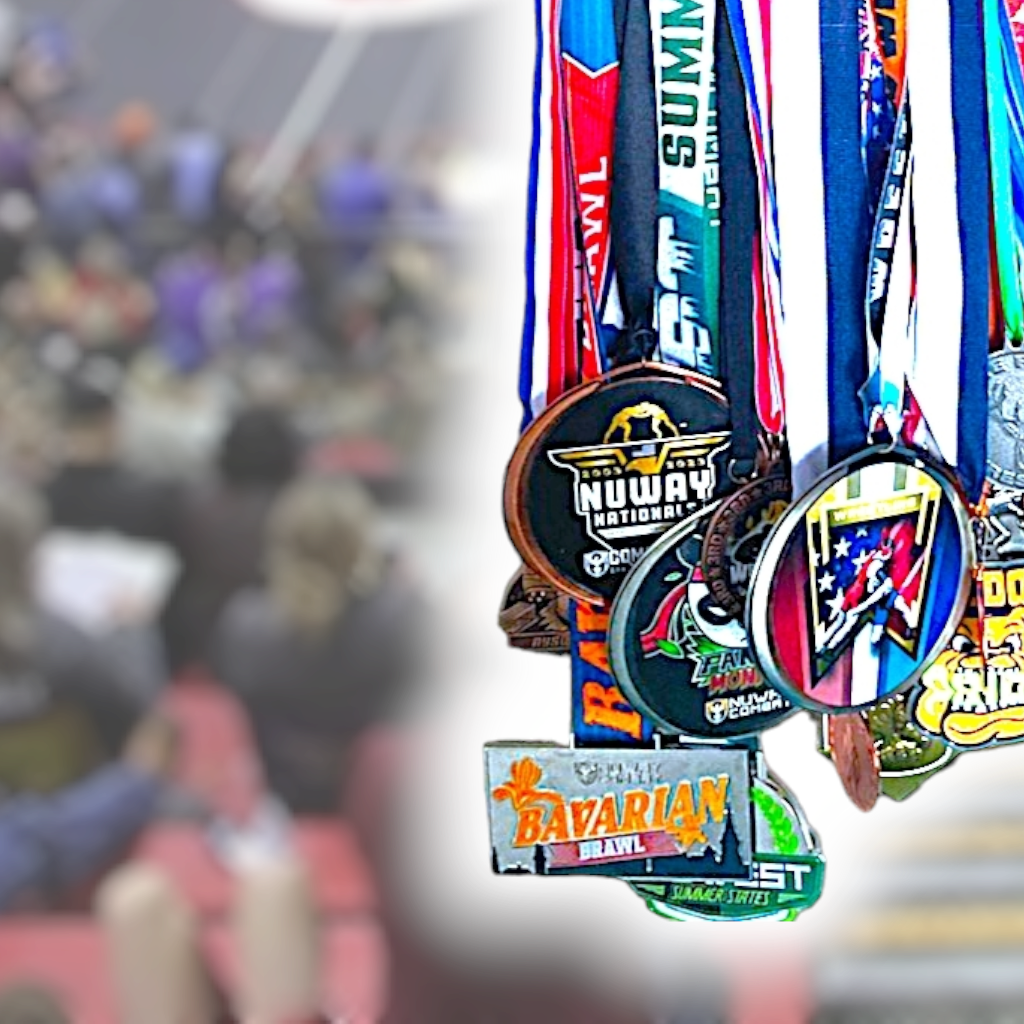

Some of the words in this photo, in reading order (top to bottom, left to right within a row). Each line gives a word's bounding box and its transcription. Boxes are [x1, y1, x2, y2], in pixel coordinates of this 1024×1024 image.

[579, 469, 711, 512] NUWAY
[513, 774, 730, 848] BAVARIAN
[578, 834, 646, 861] BRAWL
